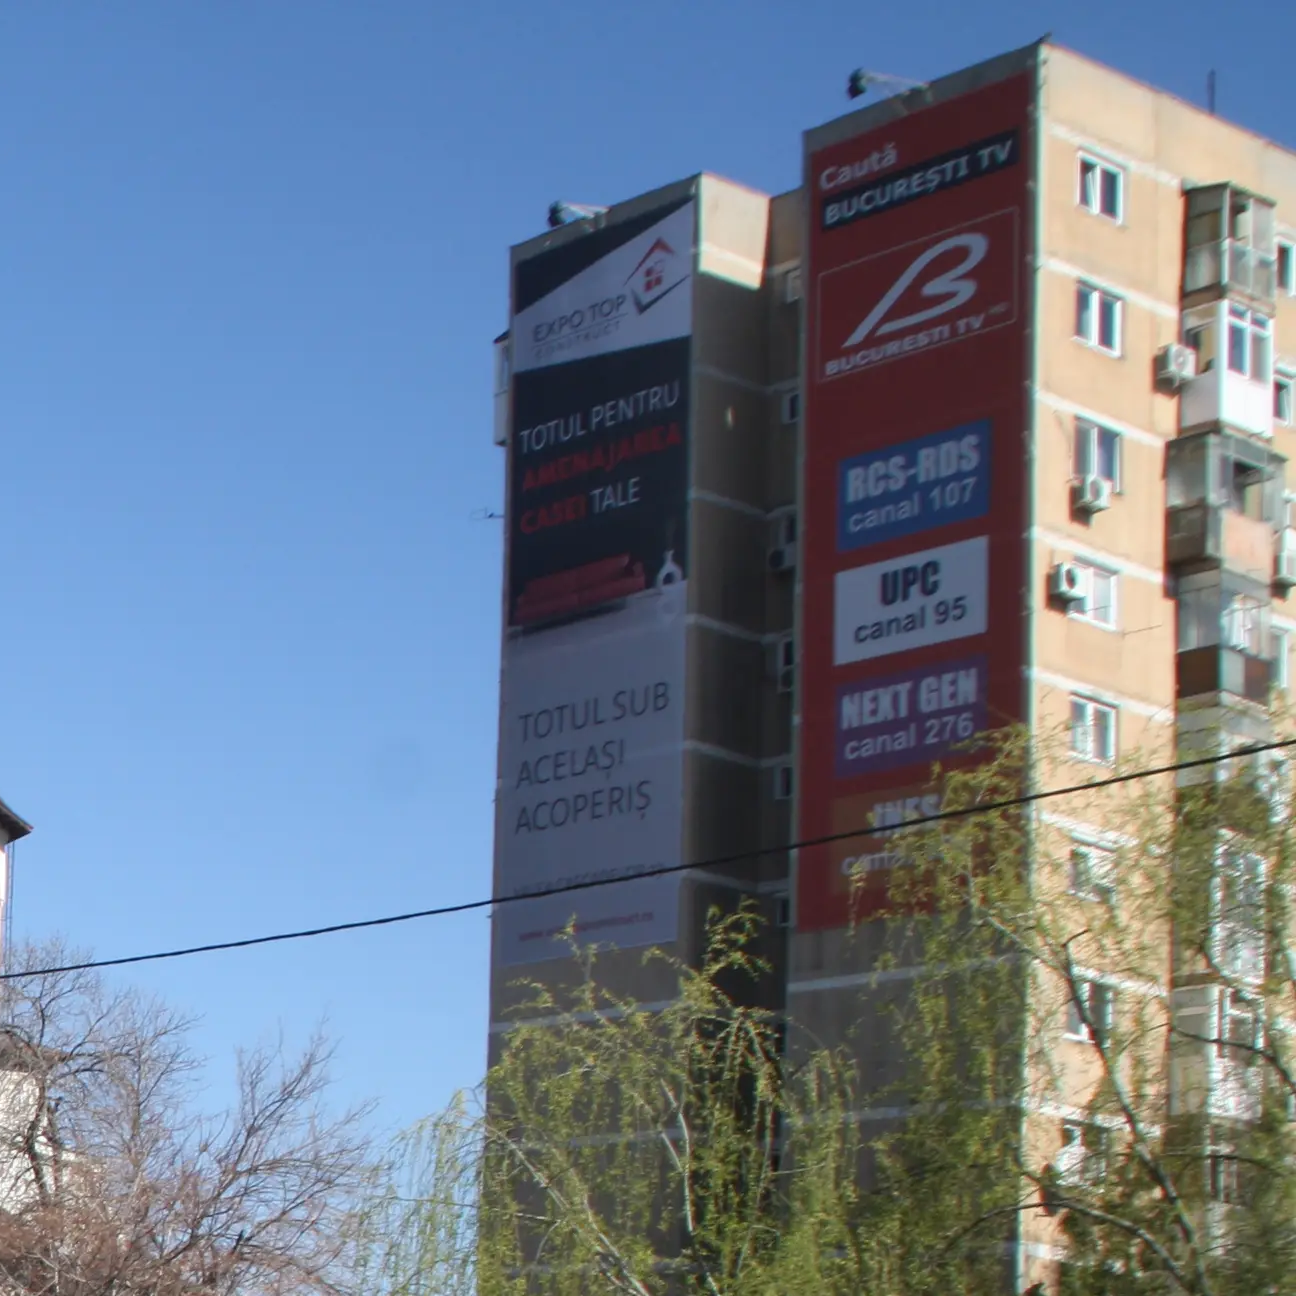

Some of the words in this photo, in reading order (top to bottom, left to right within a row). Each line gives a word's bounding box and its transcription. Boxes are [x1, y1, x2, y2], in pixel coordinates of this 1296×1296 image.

[819, 142, 898, 191] Caută
[977, 138, 1012, 170] TV
[532, 310, 585, 343] EXPO
[588, 295, 626, 322] TOP
[955, 314, 986, 335] TV
[520, 412, 587, 454] TOTUL
[591, 380, 680, 431] PENTRU
[522, 422, 682, 492] AMENAJAREA
[846, 434, 981, 504] RCS-RDS
[520, 494, 587, 535] CASEI
[590, 476, 641, 514] TALE
[848, 491, 921, 534] canal
[929, 476, 978, 512] 107
[880, 560, 941, 607] UPC
[854, 605, 927, 644] canal
[934, 595, 967, 625] 95
[519, 697, 606, 744] TOTUL
[612, 681, 670, 722] SUB
[841, 681, 913, 731] NEXT
[918, 667, 978, 714] GEN
[844, 723, 917, 760] canal
[924, 711, 974, 745] 276
[515, 739, 625, 792] ACELAȘI
[515, 780, 652, 836] ACOPERIȘ
